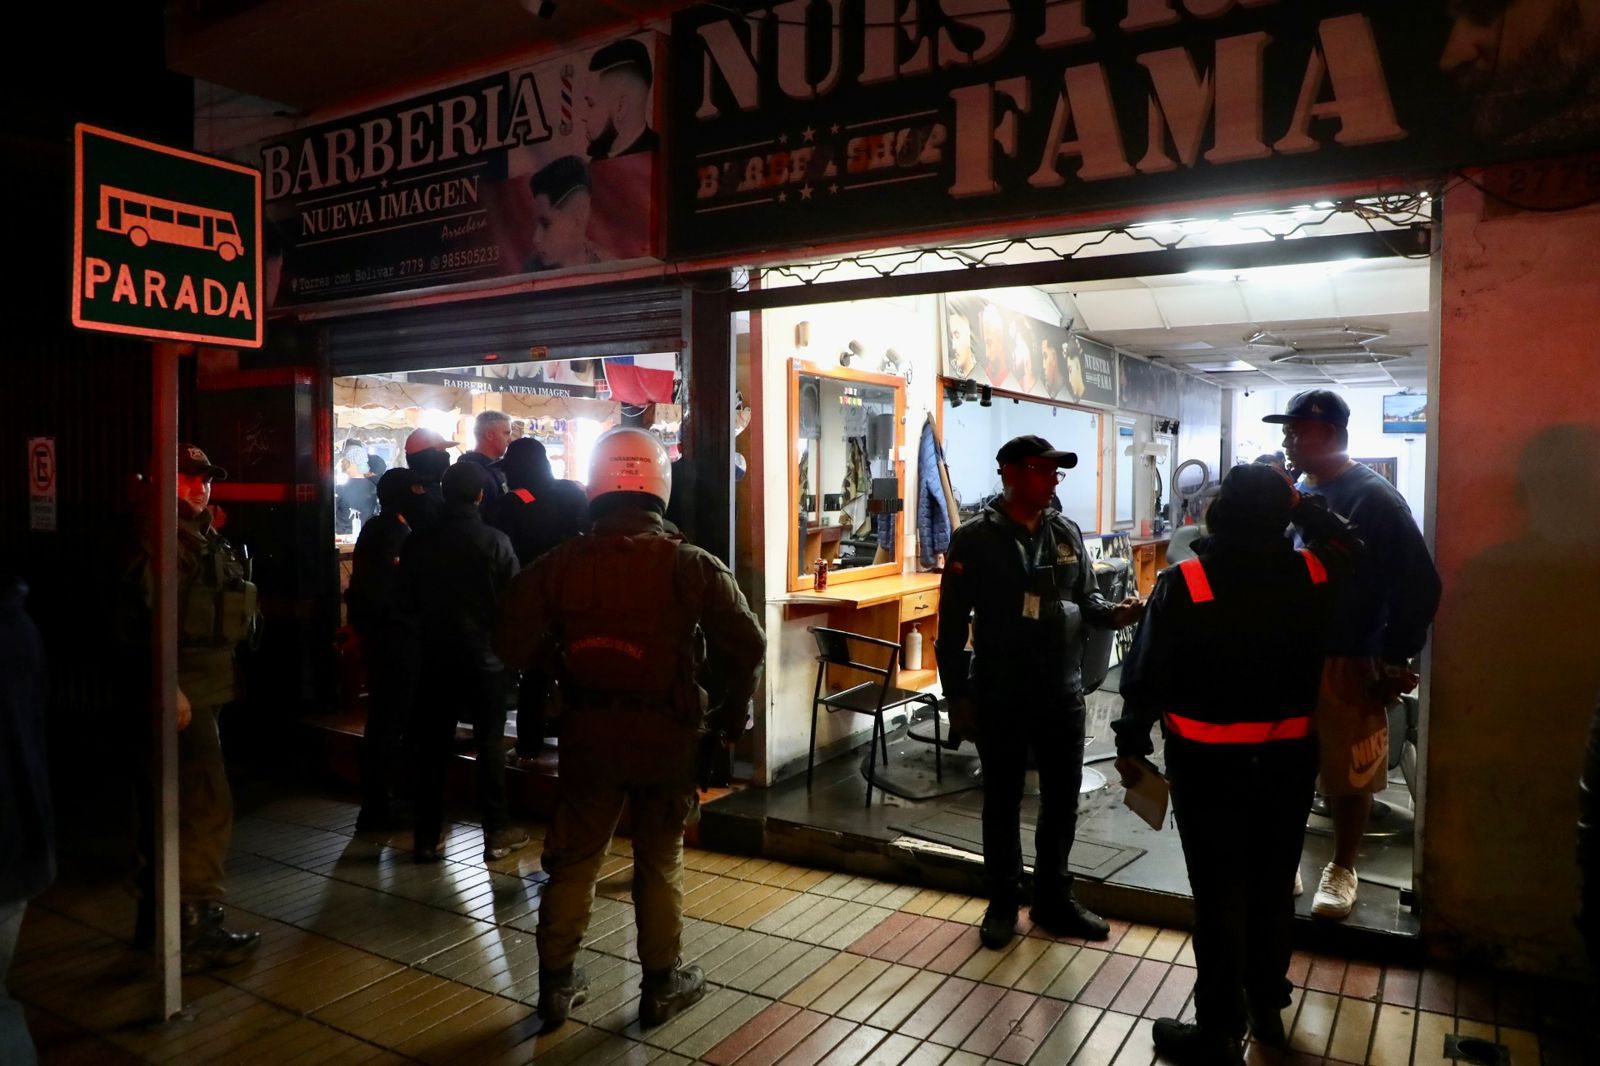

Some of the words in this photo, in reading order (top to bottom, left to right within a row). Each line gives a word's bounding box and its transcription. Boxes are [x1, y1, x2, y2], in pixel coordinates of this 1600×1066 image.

[695, 0, 1280, 121] NUES
[262, 73, 551, 201] BARBERIA
[947, 12, 1408, 199] FAMA
[301, 195, 375, 237] NUEVA
[379, 174, 480, 221] IMAGEN
[85, 256, 253, 321] PARADA
[399, 258, 424, 275] 2779
[443, 379, 493, 393] BARBERIA
[508, 385, 536, 395] NUEVA
[538, 387, 570, 398] IMAGEN
